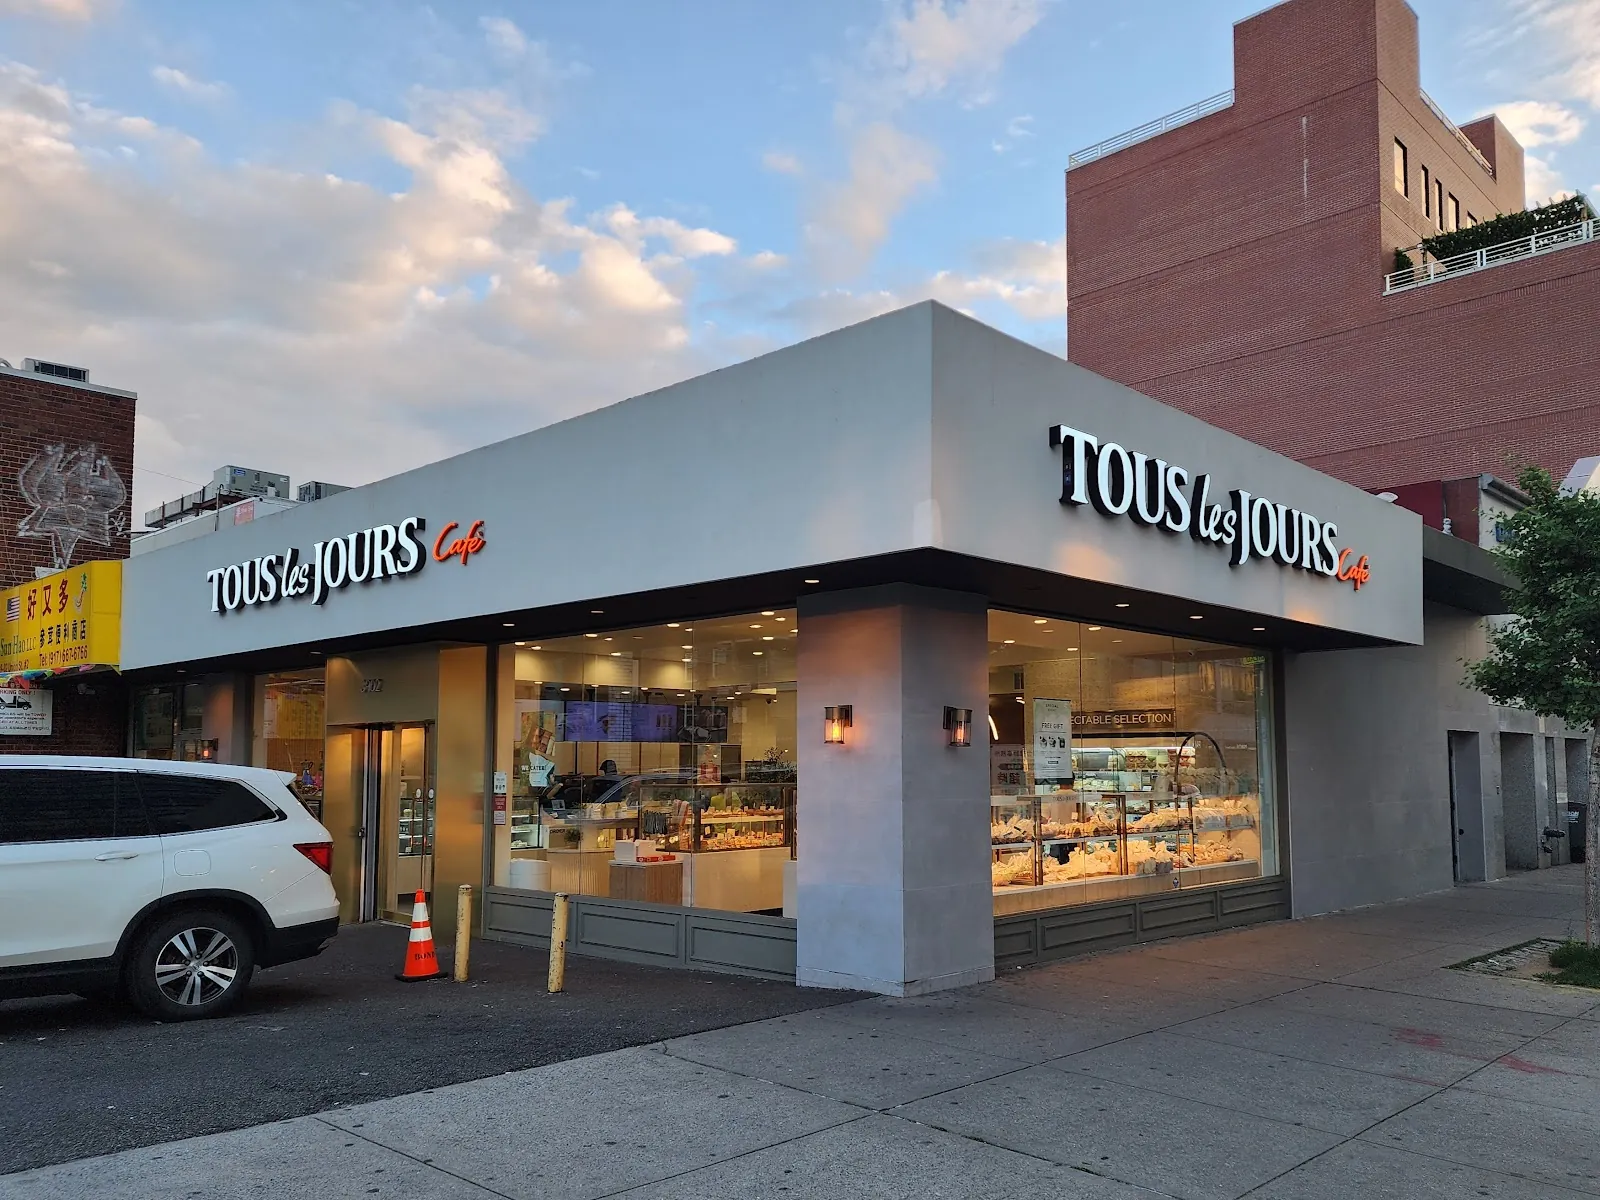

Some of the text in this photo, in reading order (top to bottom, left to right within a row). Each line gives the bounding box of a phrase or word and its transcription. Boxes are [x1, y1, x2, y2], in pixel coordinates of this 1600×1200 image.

[1050, 424, 1191, 532] TOUS
[1189, 473, 1237, 545] les
[1229, 489, 1339, 577] JOURS
[207, 554, 283, 613] TOUS
[280, 548, 314, 599] les
[311, 516, 427, 606] JOURS
[27, 578, 69, 621] 好又多
[13, 634, 26, 655] Hao
[1113, 713, 1172, 724] SELECTION
